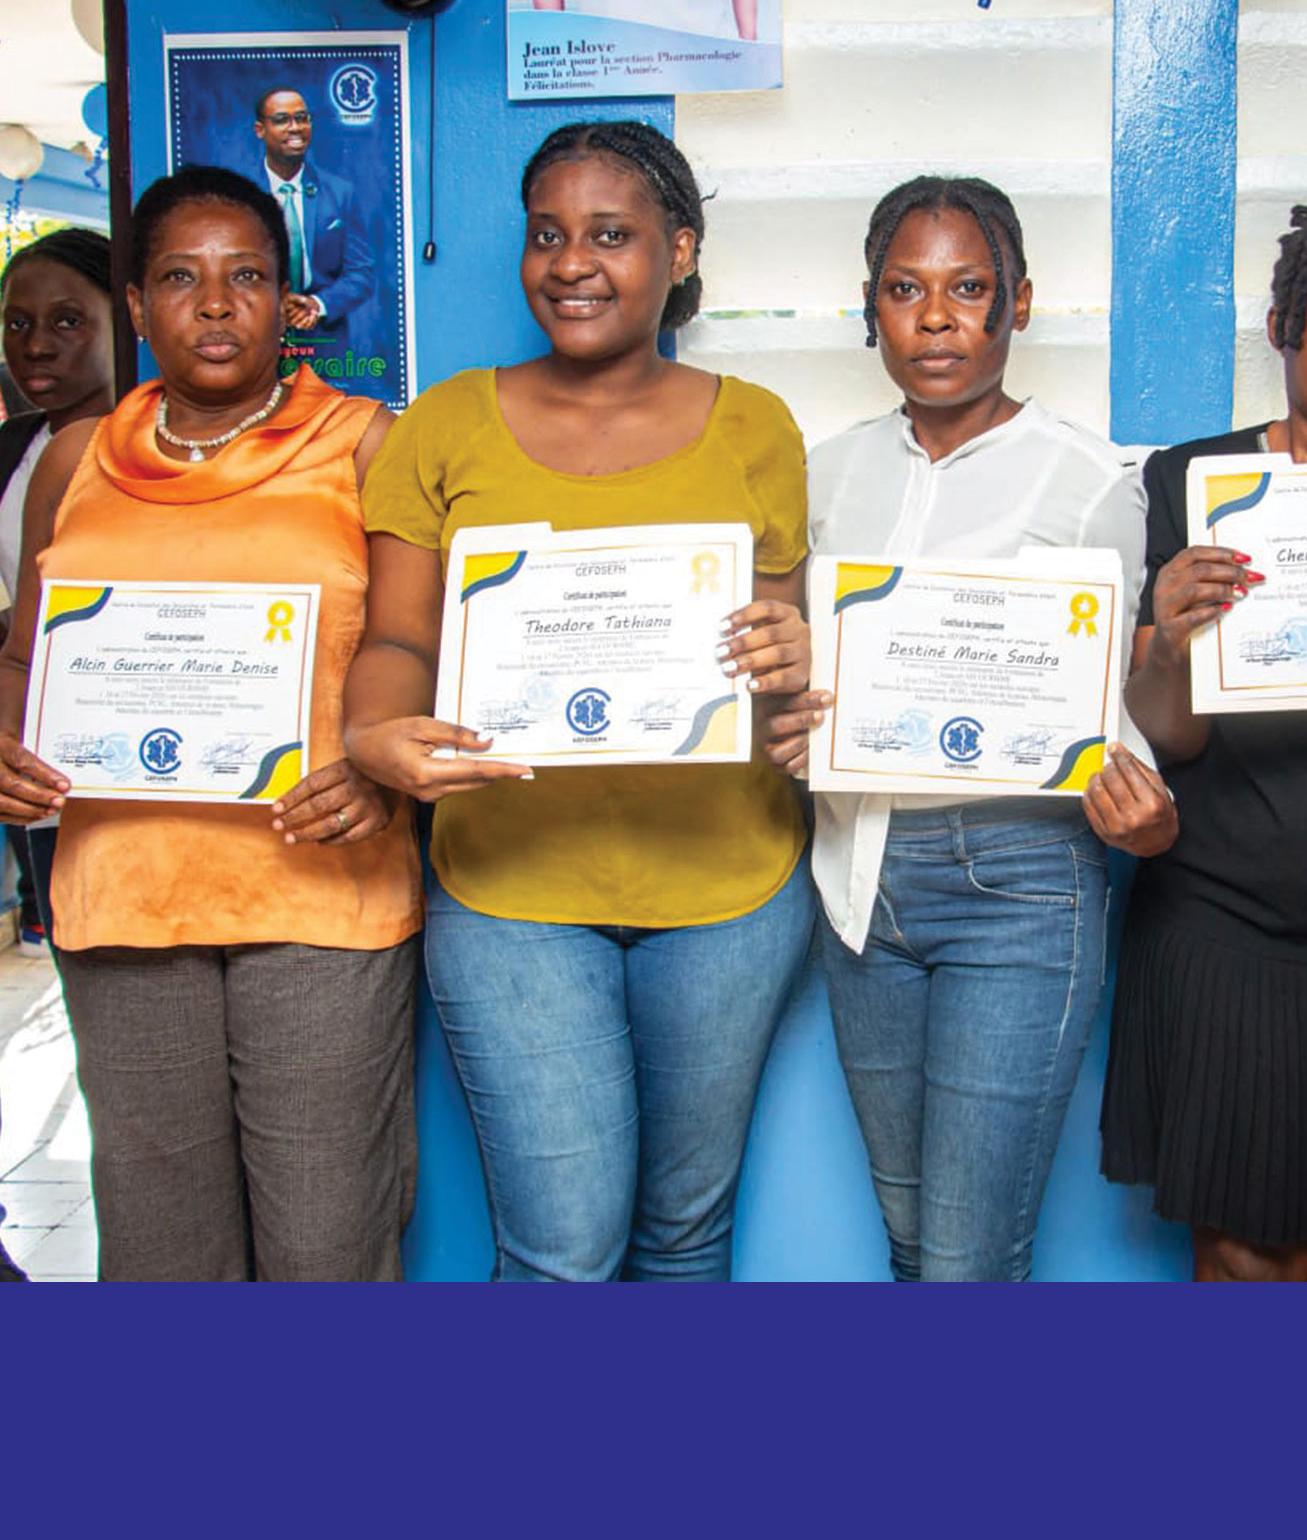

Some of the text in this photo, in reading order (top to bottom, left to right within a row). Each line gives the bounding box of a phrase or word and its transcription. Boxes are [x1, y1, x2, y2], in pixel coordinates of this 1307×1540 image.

[522, 40, 616, 58] Jean Islove
[953, 592, 1005, 607] CEFOSEPH
[525, 615, 672, 635] Theodore Tathiana
[887, 641, 1059, 666] Destiné Marie Sandra
[69, 658, 278, 675] Alcin Guerrier Marie Denise
